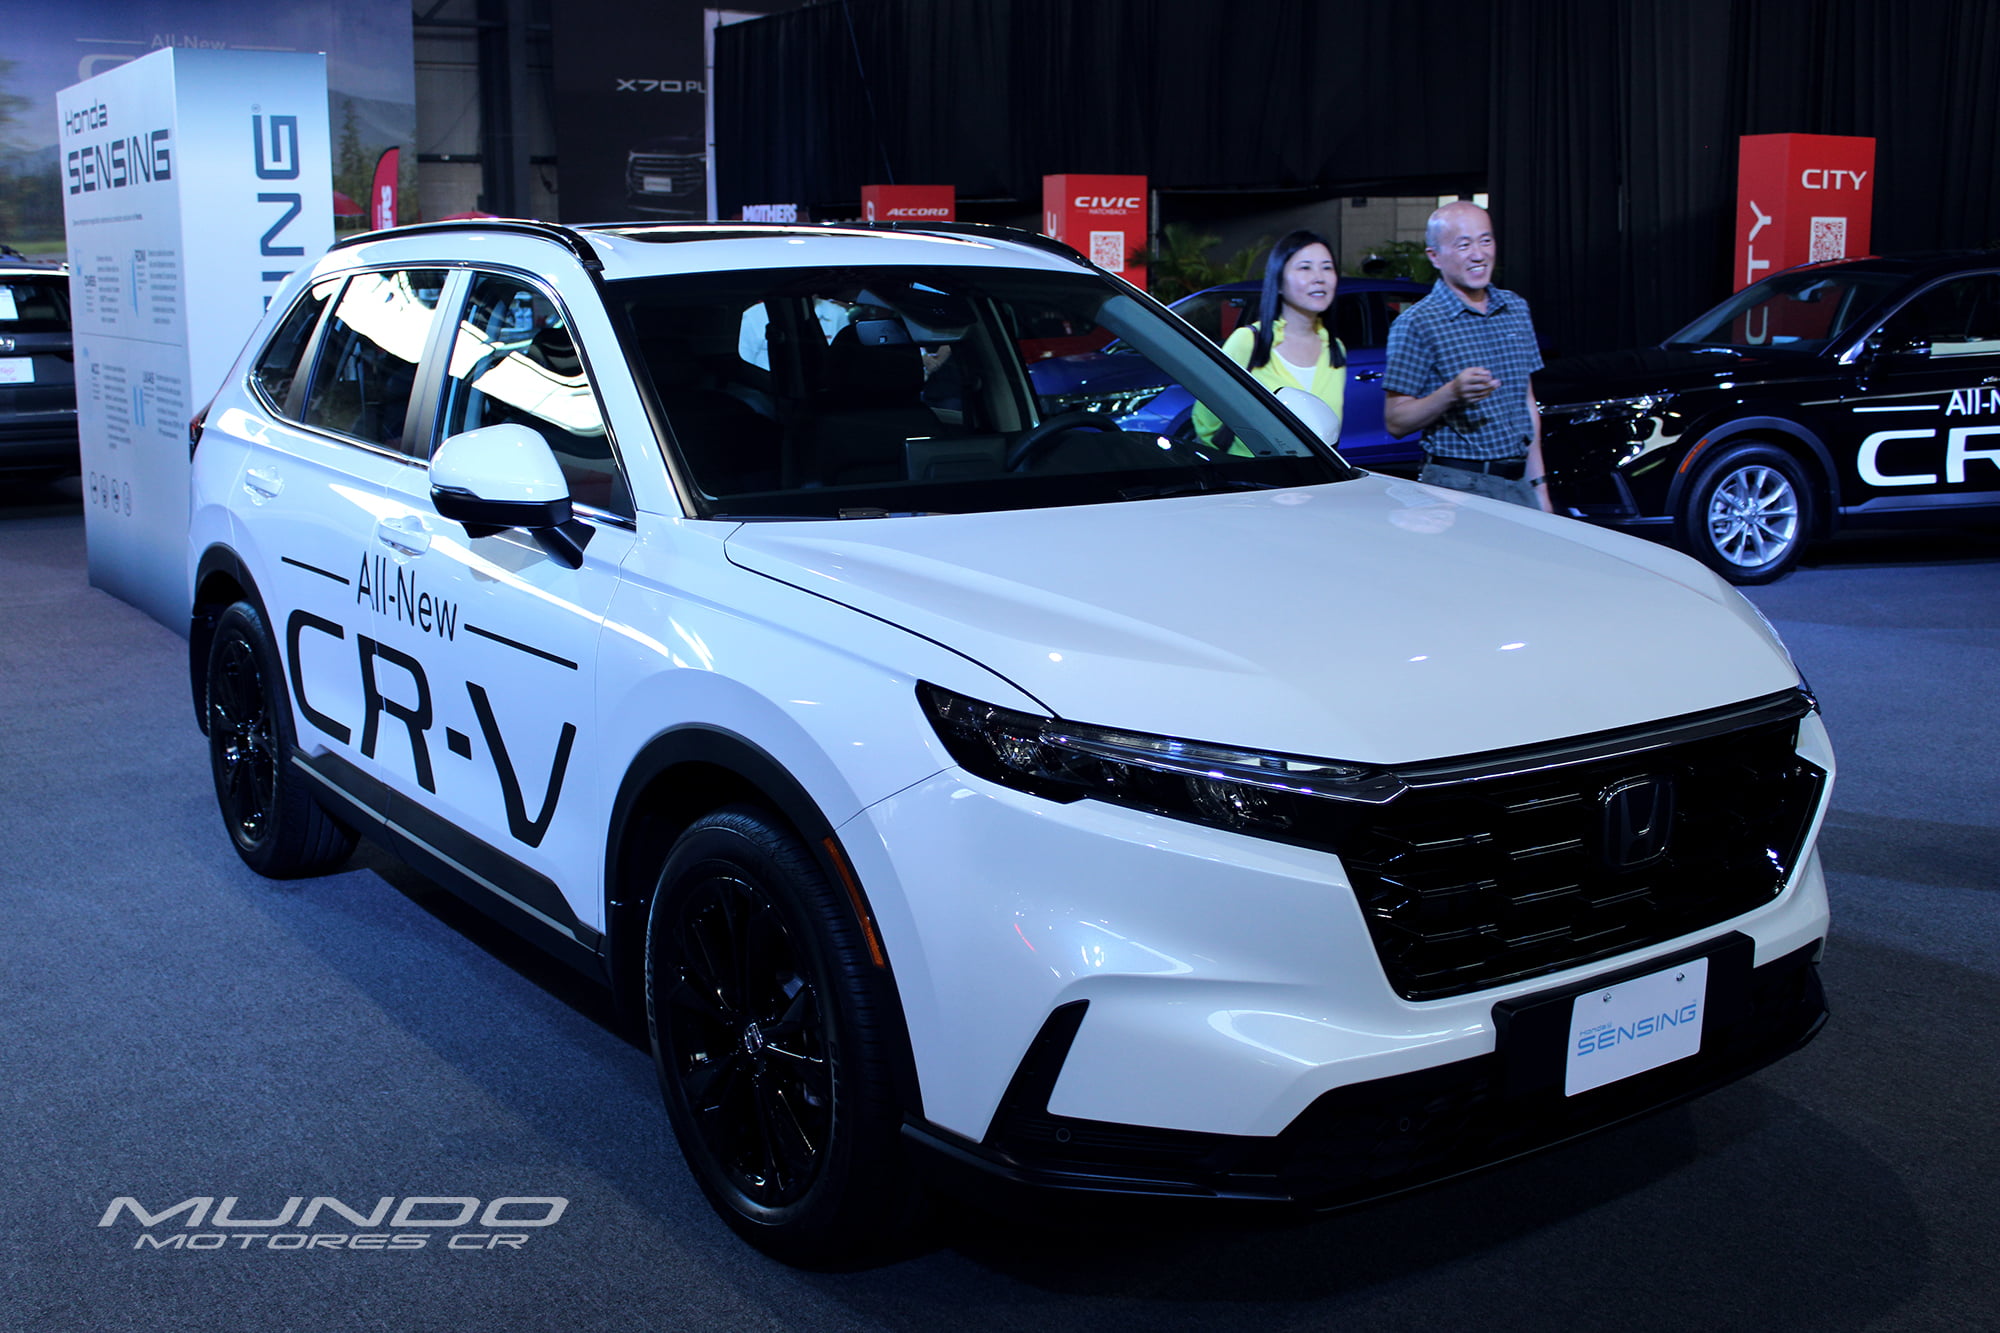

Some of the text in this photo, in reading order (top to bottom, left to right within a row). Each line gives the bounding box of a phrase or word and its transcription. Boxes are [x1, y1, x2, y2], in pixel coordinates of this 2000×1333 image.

[616, 79, 682, 92] X70
[65, 98, 108, 136] Honda
[68, 129, 171, 195] SENSING
[1801, 169, 1867, 190] CITY
[252, 115, 305, 312] ING
[886, 208, 949, 216] ACCORD
[1074, 196, 1141, 208] CIVIC
[1745, 200, 1772, 345] CTY
[357, 551, 457, 642] All-New
[286, 609, 577, 848] CR-V
[1577, 1003, 1697, 1057] SENSING
